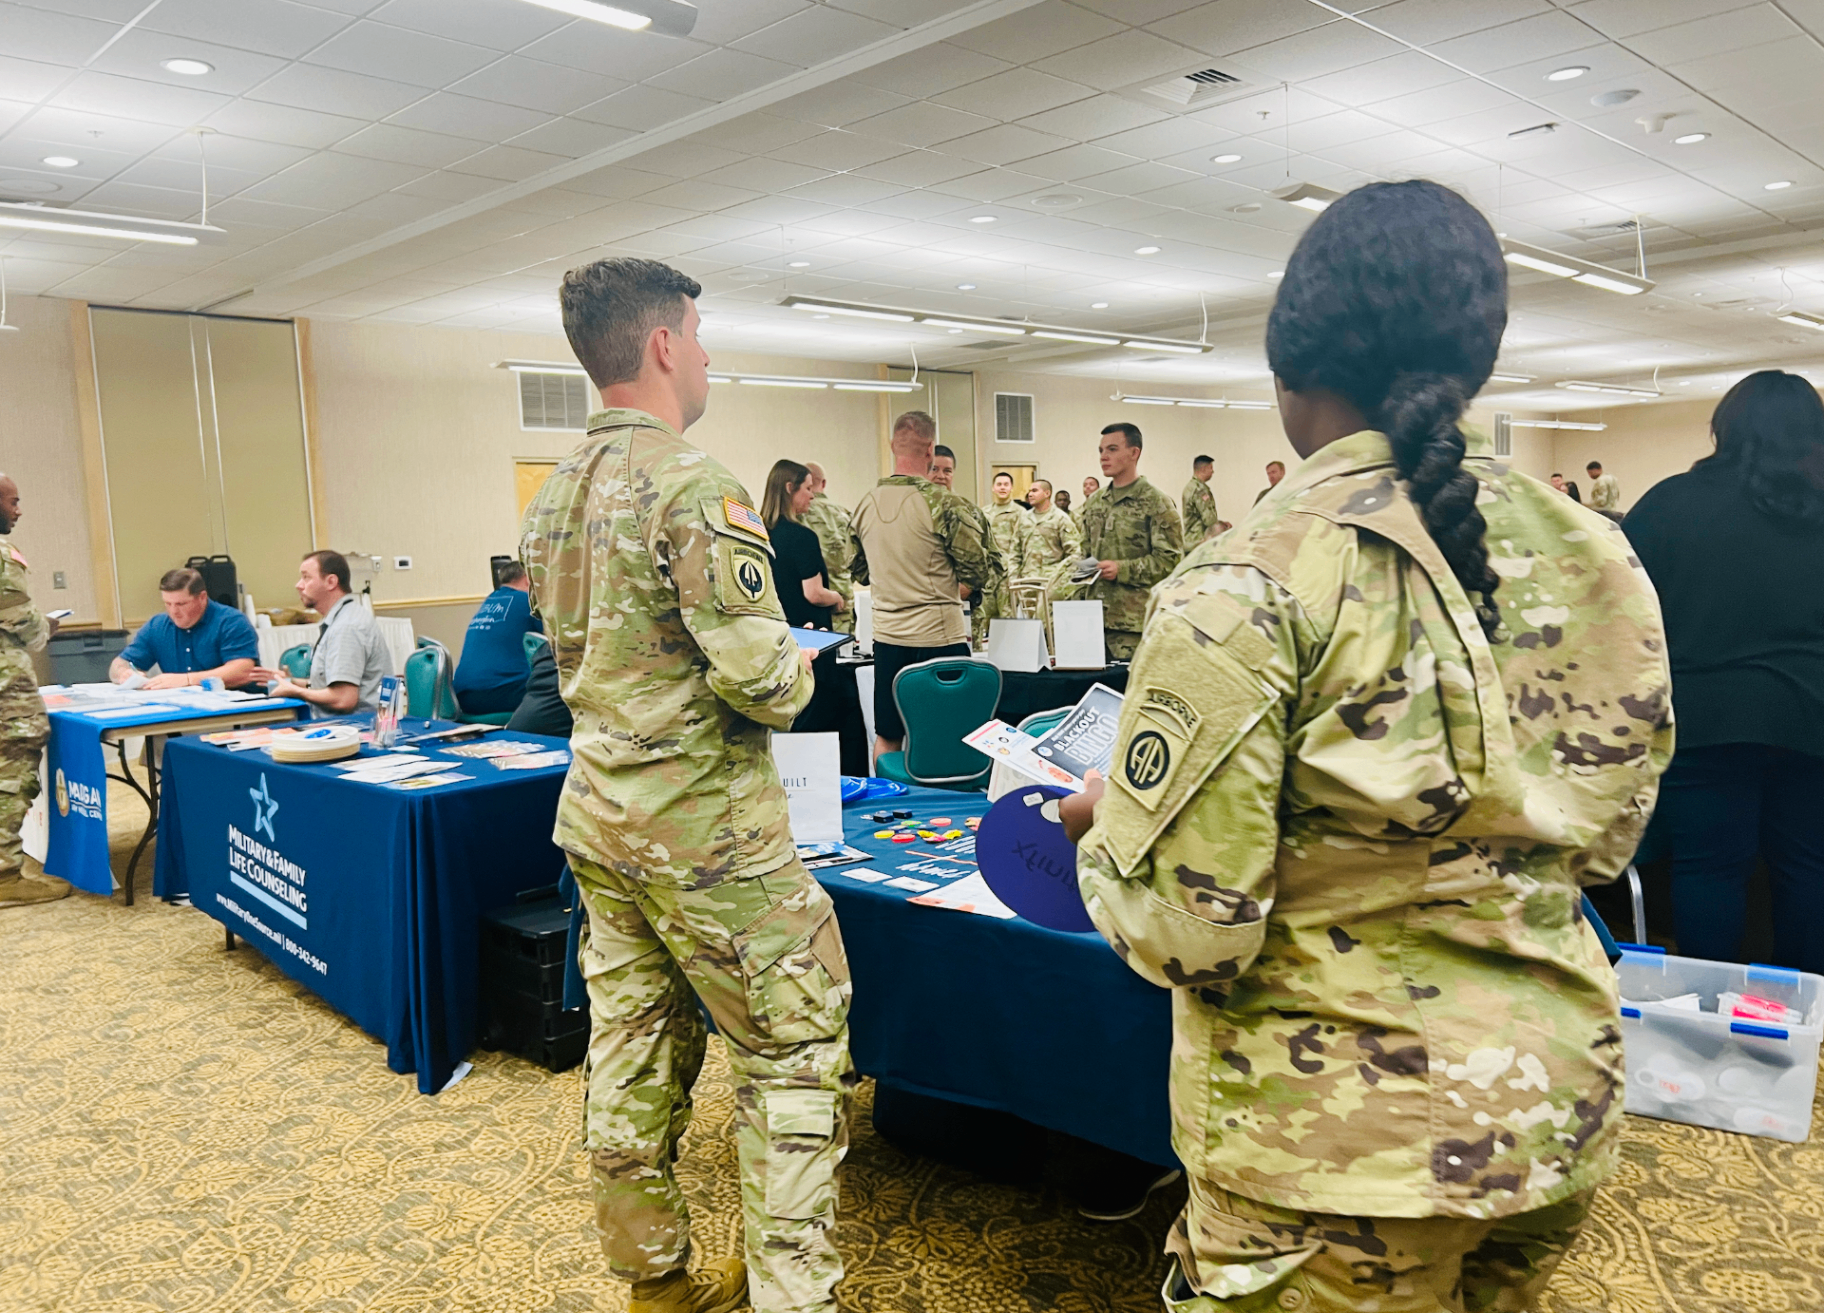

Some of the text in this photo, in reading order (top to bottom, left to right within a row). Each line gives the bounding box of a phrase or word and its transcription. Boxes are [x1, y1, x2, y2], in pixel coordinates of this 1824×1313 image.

[1053, 706, 1100, 752] BLACKOUT
[1063, 712, 1119, 766] BINGO
[782, 777, 807, 788] UILT
